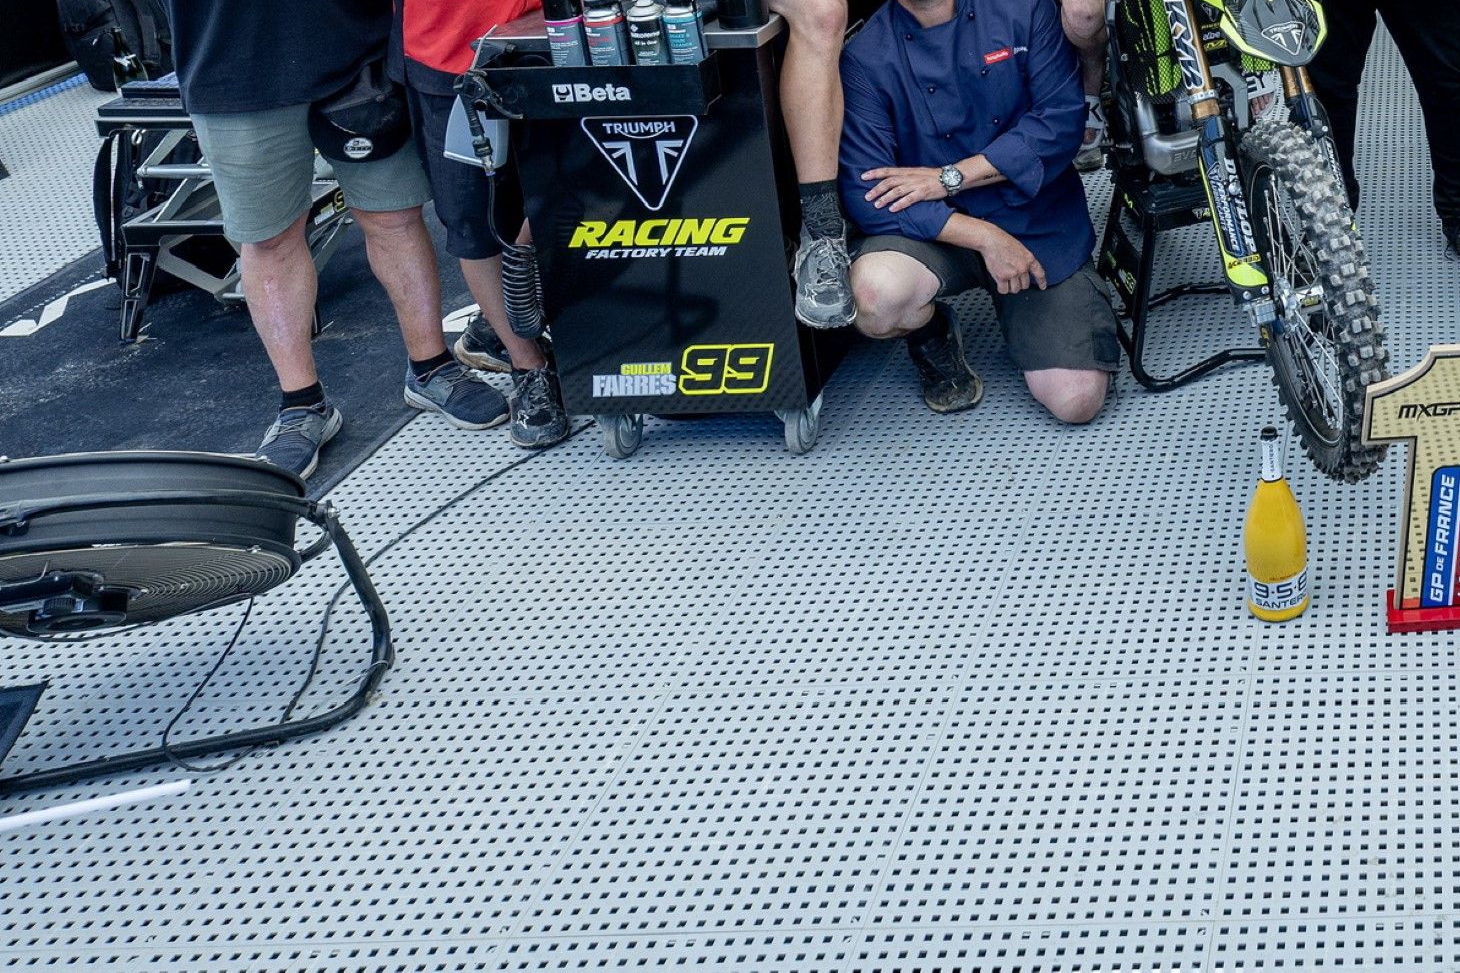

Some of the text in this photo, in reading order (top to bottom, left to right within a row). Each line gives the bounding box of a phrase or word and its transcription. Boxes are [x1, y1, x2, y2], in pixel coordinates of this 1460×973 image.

[575, 83, 632, 103] Beta
[603, 121, 676, 134] TRIUMPH
[568, 217, 751, 248] RACING
[585, 246, 727, 260] FACTORY TEAM
[620, 362, 672, 375] GUILLEM
[678, 343, 775, 396] 99
[592, 373, 677, 398] FARRES
[1434, 473, 1456, 555] FRANCE
[1430, 574, 1444, 603] GP
